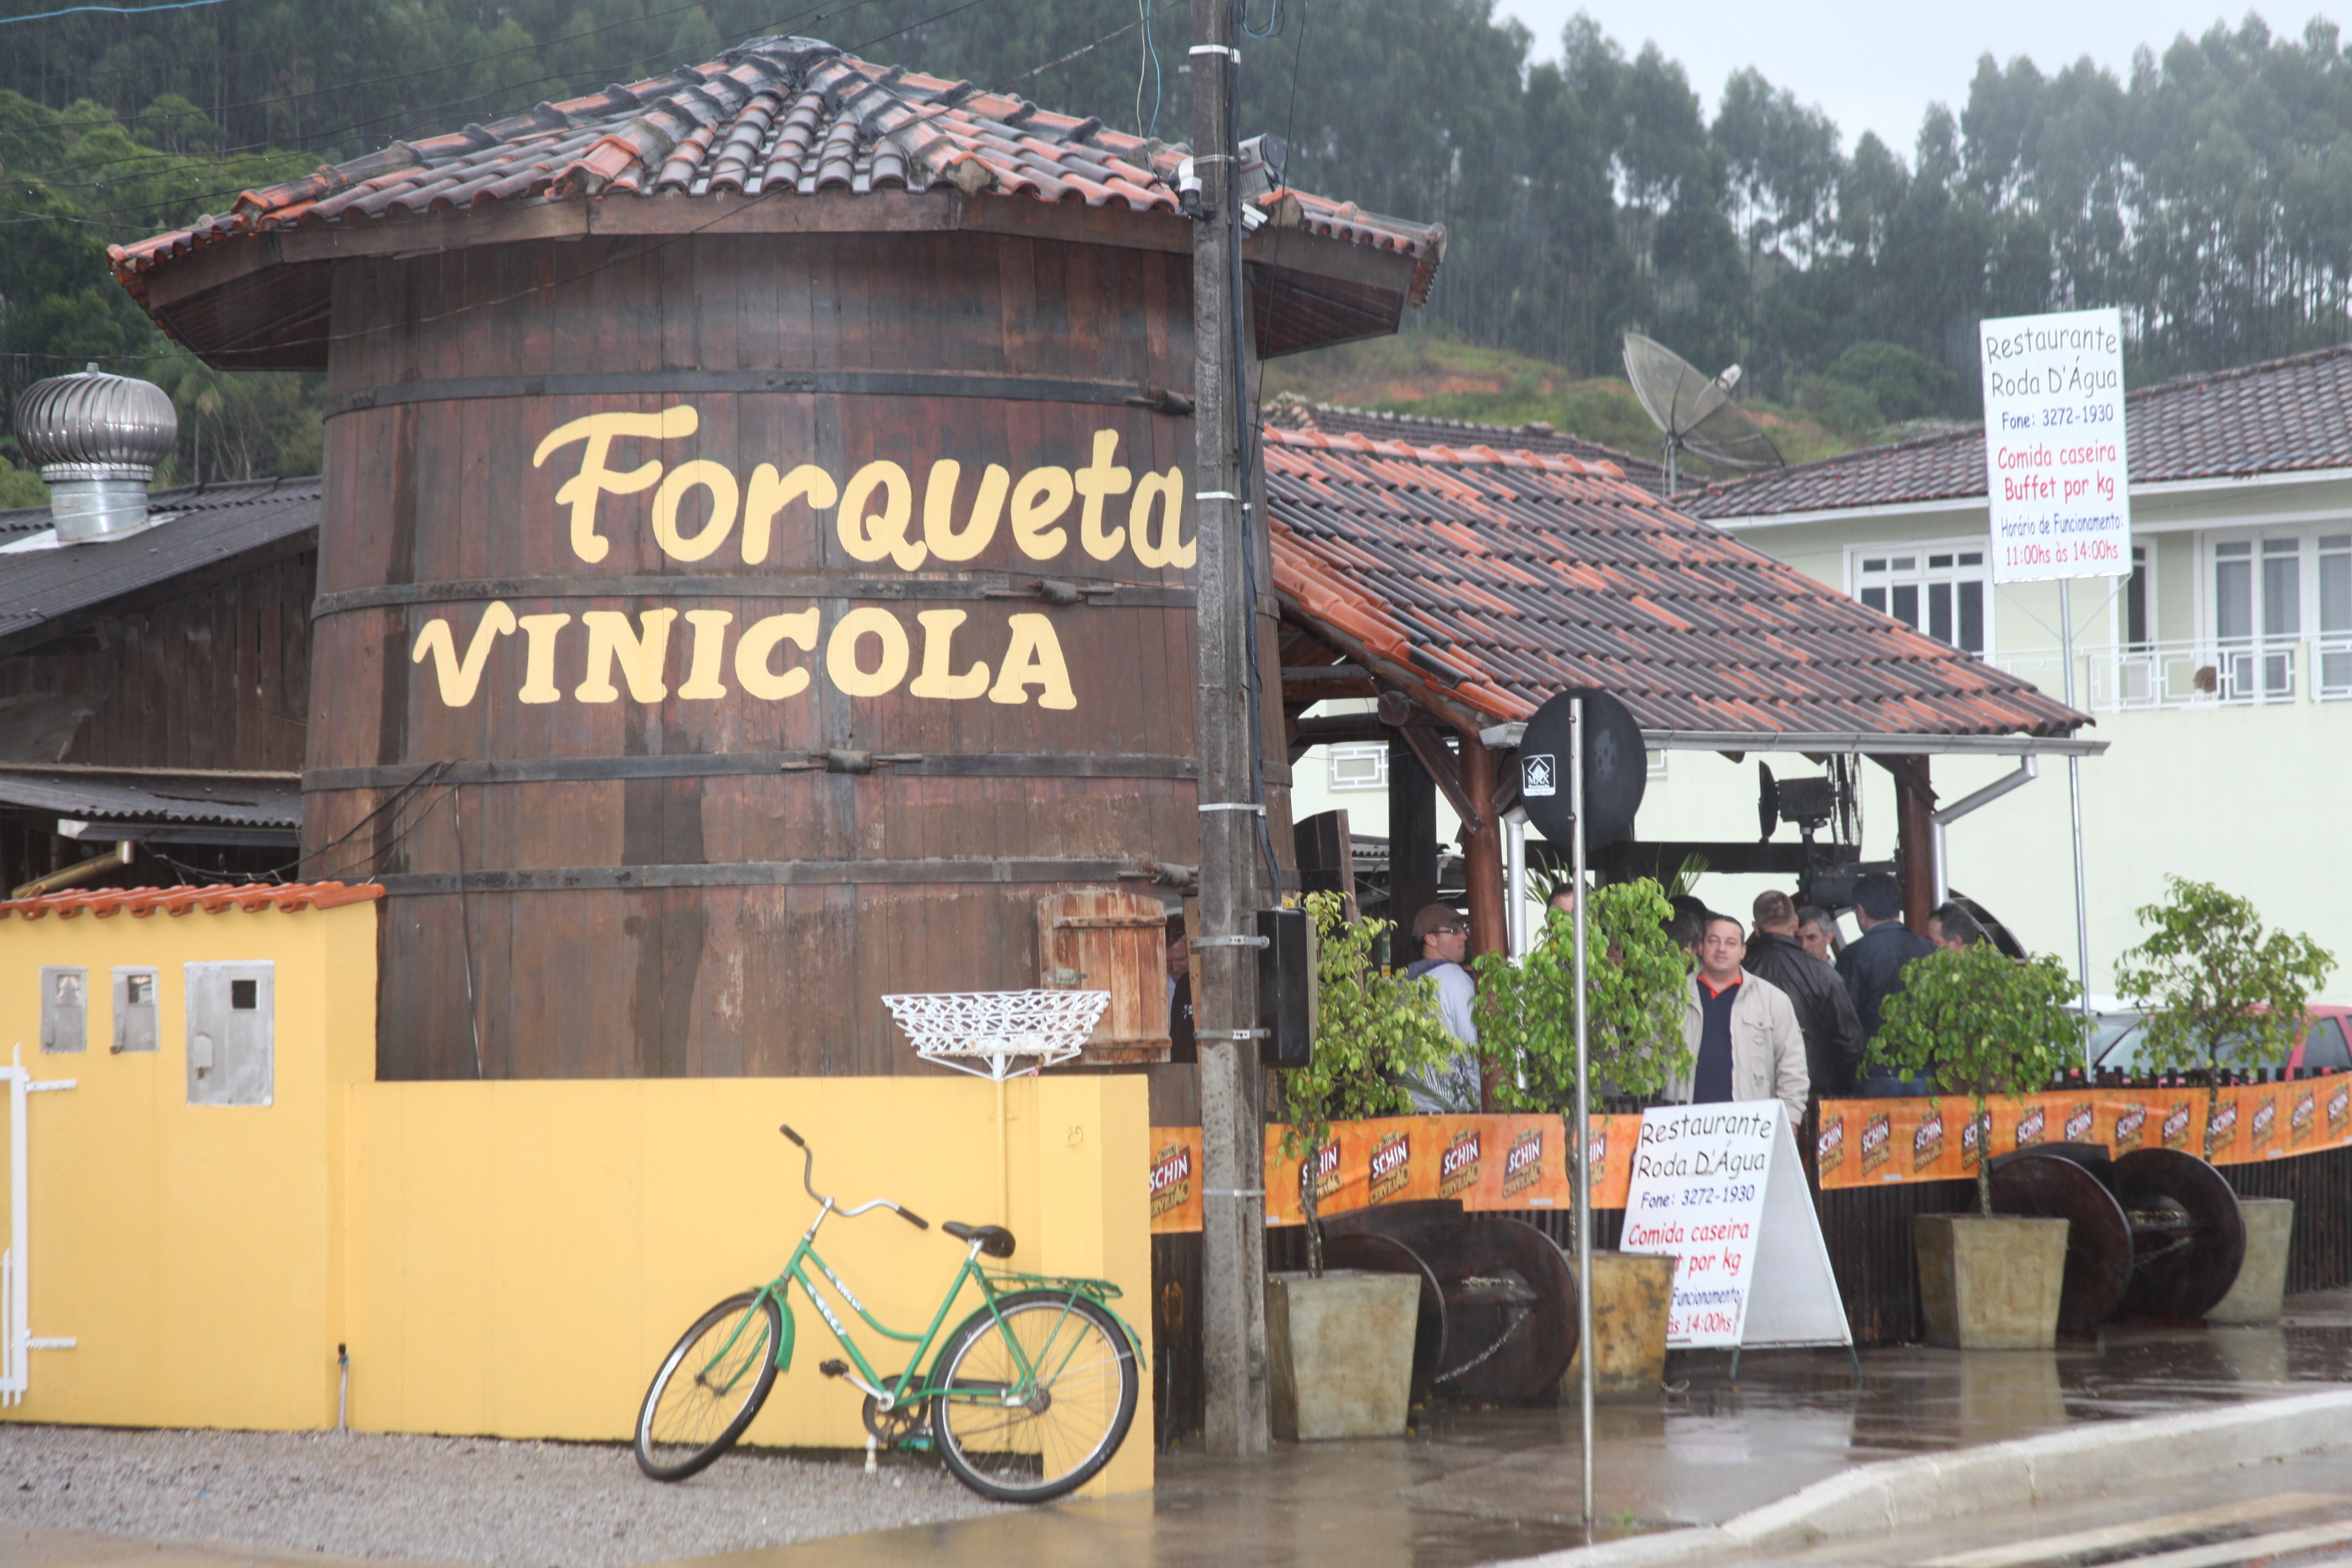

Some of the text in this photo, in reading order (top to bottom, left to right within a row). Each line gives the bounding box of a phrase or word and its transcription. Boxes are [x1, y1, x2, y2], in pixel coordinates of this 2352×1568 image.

[1986, 326, 2117, 365] Restaurante
[1991, 355, 2118, 398] Roda D'Água
[2002, 404, 2114, 432] Fone: 3272-1930
[1998, 440, 2116, 470] Comida caseira
[2005, 470, 2115, 504] Buffet por kg
[2001, 512, 2124, 538] Horário de Funcionamento:
[2006, 540, 2118, 566] 11:00hs às 14:00hs
[412, 601, 1077, 710] VINICOLA
[1641, 1113, 1772, 1149] Restaurante
[1819, 1123, 1843, 1156] SCHIN
[1863, 1120, 1889, 1152] SCHIN
[1915, 1118, 1942, 1150] SCHIN
[1964, 1114, 1990, 1147] SCN
[2017, 1112, 2044, 1144] SCHIN
[2066, 1109, 2091, 1141] SCHIN
[2117, 1108, 2145, 1139] SCHIN
[2164, 1108, 2189, 1138] SCHIN
[1302, 1146, 1337, 1185] SHIN
[1373, 1141, 1407, 1179] SCHIN
[1444, 1139, 1478, 1175] SCHIN
[1508, 1139, 1540, 1173] SCHIN
[1637, 1152, 1687, 1179] Roda
[1695, 1141, 1765, 1180] D'Água
[1150, 1154, 1188, 1193] SCHIN
[1641, 1184, 1755, 1210] Fone: 3272-1930
[1628, 1217, 1750, 1246] Comida caseira
[1688, 1255, 1716, 1279] por
[1723, 1246, 1741, 1277] kg
[1685, 1312, 1732, 1333] 14:00hs
